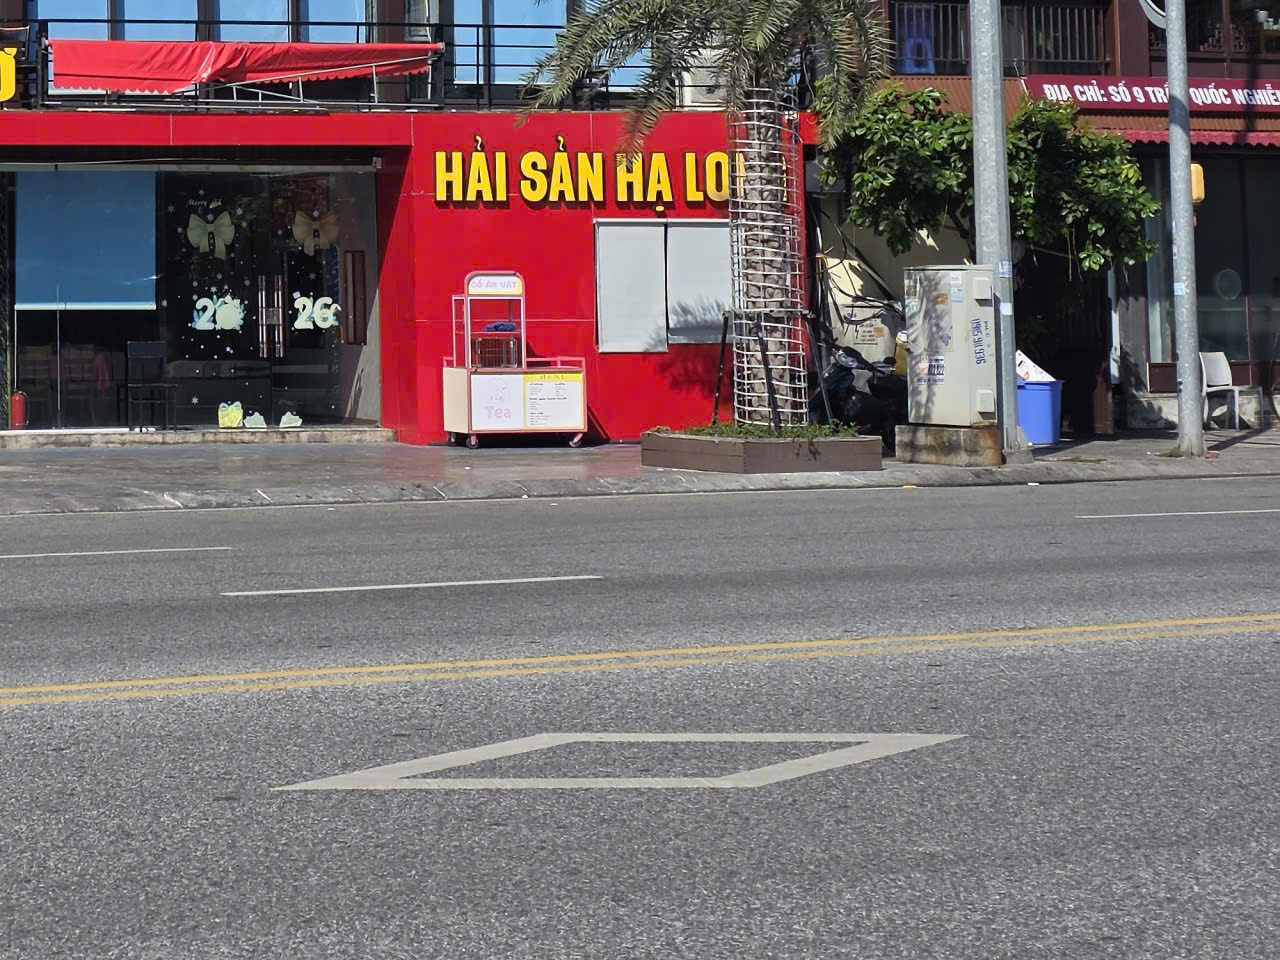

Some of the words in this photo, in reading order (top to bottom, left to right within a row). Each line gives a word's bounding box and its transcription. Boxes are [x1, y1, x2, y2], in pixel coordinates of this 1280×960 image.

[1042, 84, 1073, 105] ĐỊA
[1074, 80, 1108, 102] CHỈ:
[1108, 80, 1131, 103] SỐ
[1132, 86, 1145, 103] 9
[1189, 82, 1232, 106] QUỐC
[435, 135, 507, 201] HẢI
[520, 135, 603, 202] SẢN
[616, 152, 673, 212] HẠ
[484, 407, 512, 420] Tea
